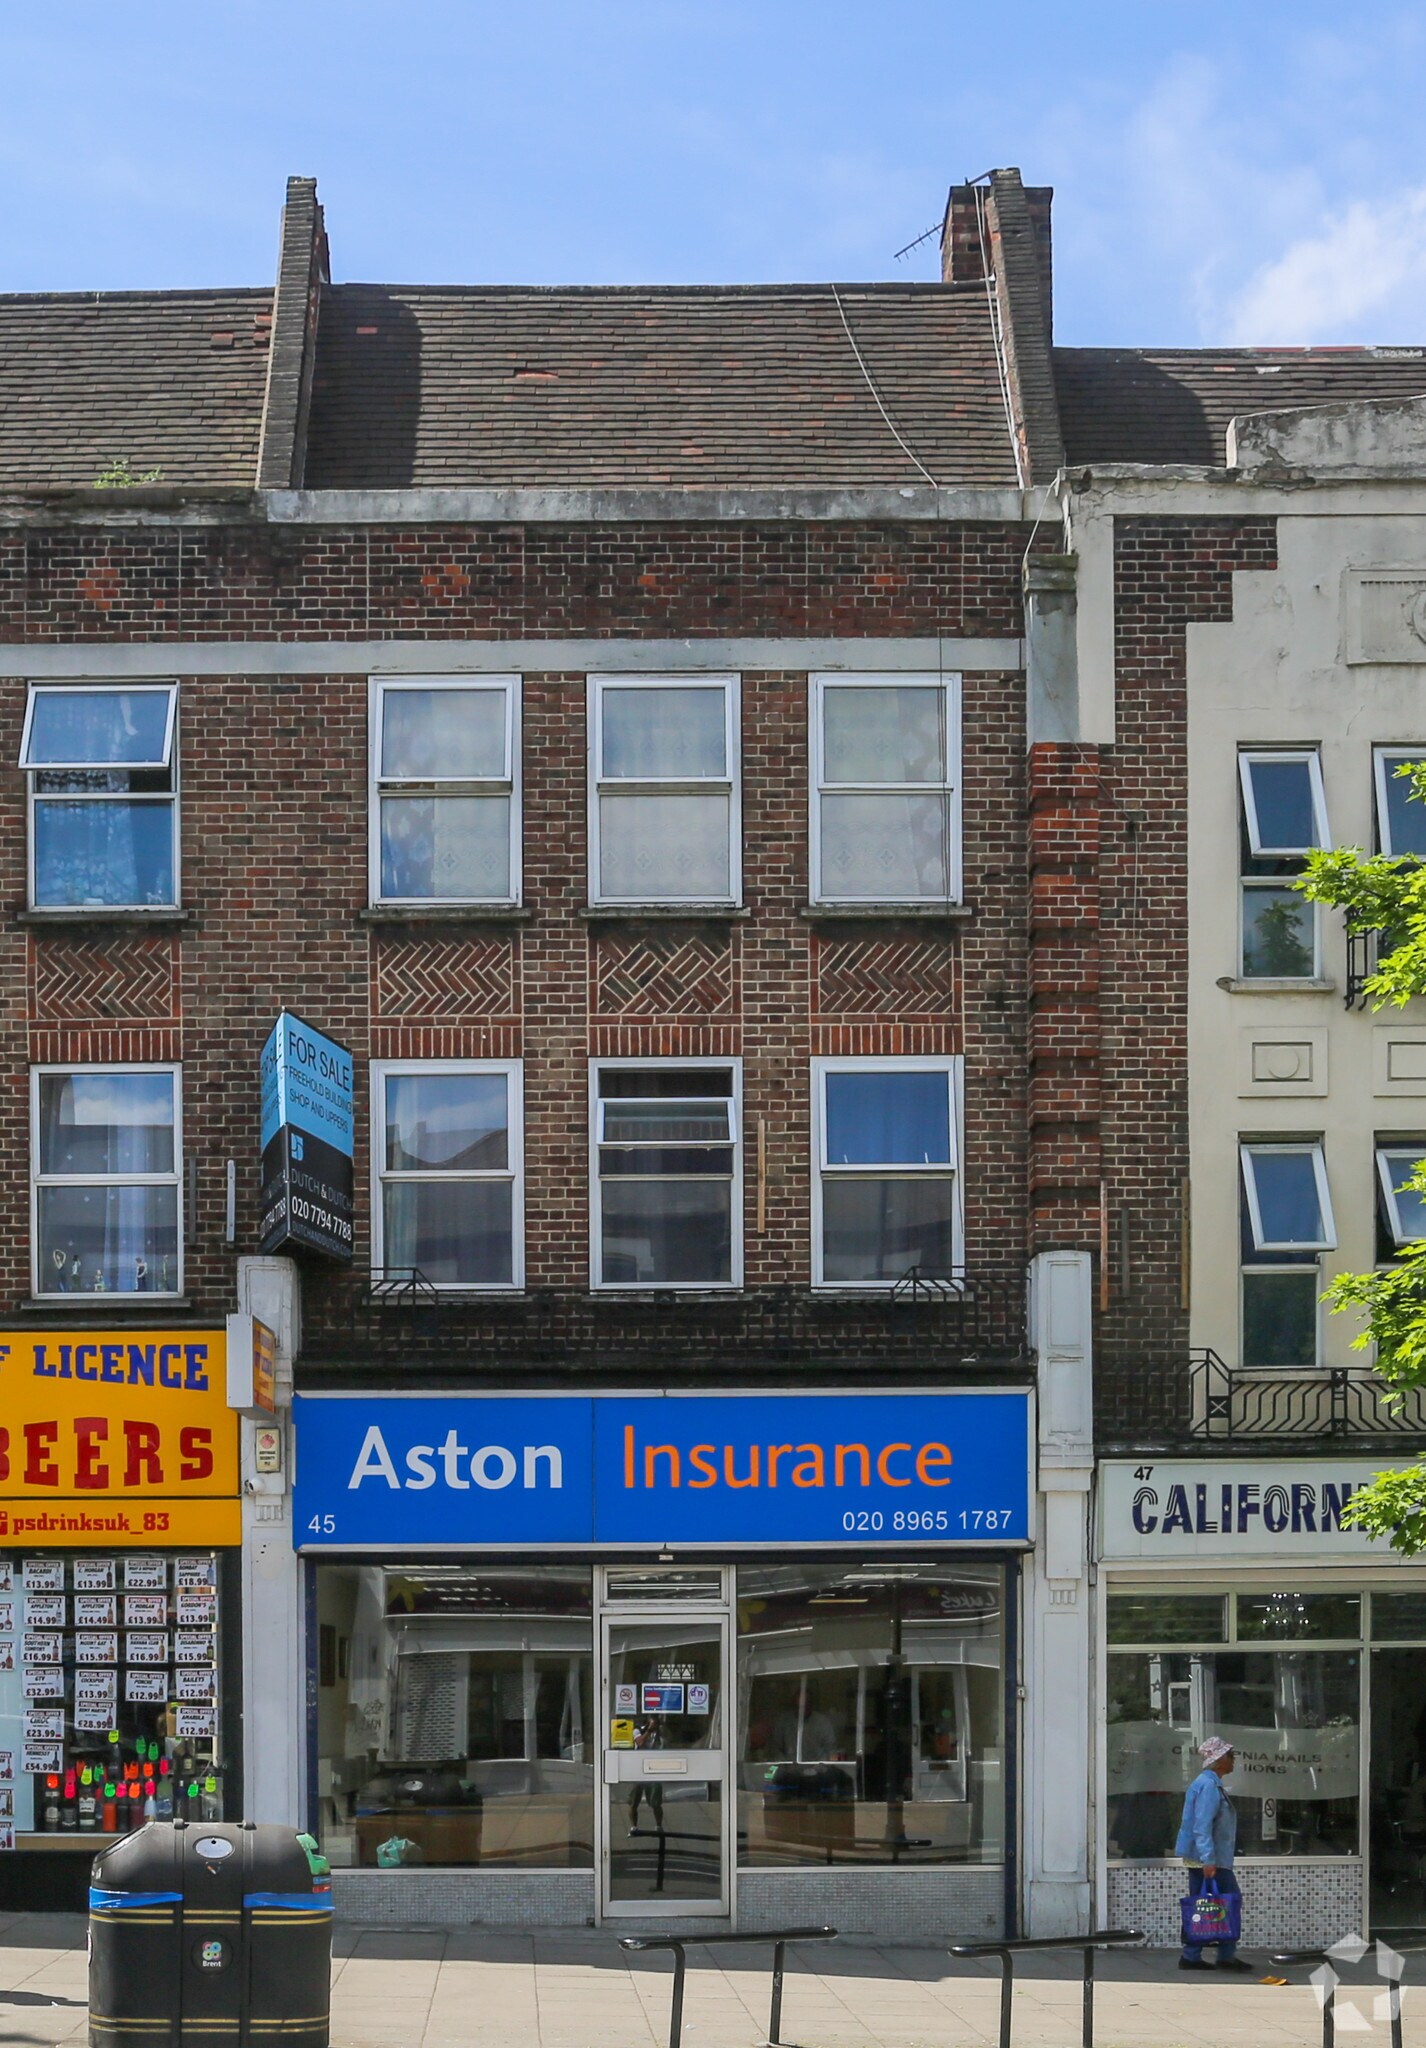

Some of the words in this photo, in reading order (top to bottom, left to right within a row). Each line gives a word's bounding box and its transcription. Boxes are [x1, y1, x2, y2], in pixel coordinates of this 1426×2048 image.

[289, 1031, 316, 1071] FOR
[320, 1051, 349, 1092] SALE
[289, 1066, 323, 1096] FREEHOLD
[325, 1087, 351, 1114] BUILDING
[290, 1089, 309, 1108] SHOP
[311, 1101, 324, 1118] AND
[326, 1111, 348, 1133] UPPERS
[292, 1169, 319, 1194] DUTCH
[321, 1184, 327, 1199] &
[329, 1187, 351, 1210] DUTCH
[292, 1196, 309, 1219] 020
[311, 1205, 331, 1230] 7794
[334, 1217, 351, 1241] 7788
[33, 1344, 209, 1391] LICENCE
[0, 1417, 213, 1490] EERS
[348, 1425, 563, 1490] Aston
[624, 1424, 954, 1489] Insurance
[1133, 1466, 1154, 1481] 47
[13, 1512, 170, 1535] psdrinksuk_83
[308, 1514, 336, 1534] 45
[842, 1511, 884, 1531] 020
[892, 1511, 949, 1531] 8965
[958, 1510, 1013, 1530] 1787
[1132, 1483, 1402, 1535] CALIFORN
[78, 1580, 106, 1588] £13.99
[180, 1689, 208, 1697] £12.99
[78, 1720, 107, 1728] £28.99
[180, 1727, 208, 1735] £12.99
[1274, 1752, 1322, 1763] NAILS
